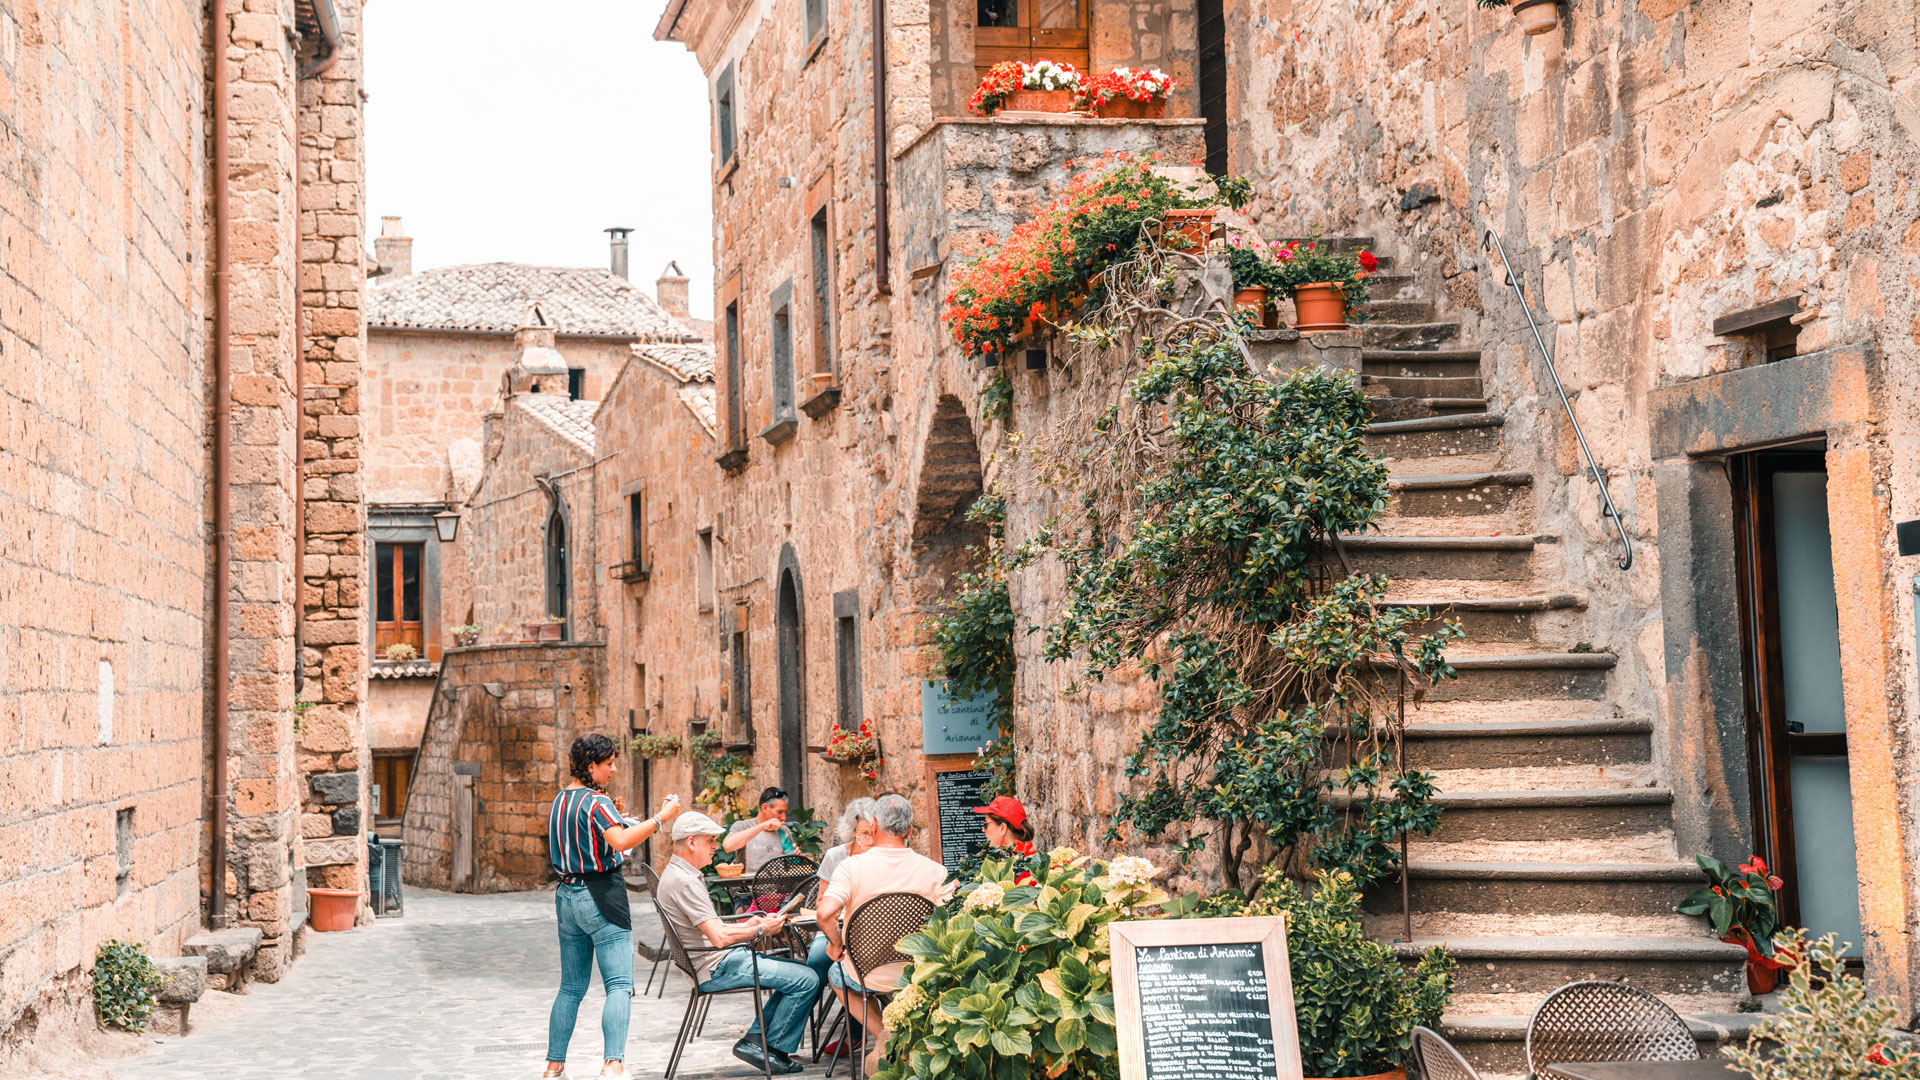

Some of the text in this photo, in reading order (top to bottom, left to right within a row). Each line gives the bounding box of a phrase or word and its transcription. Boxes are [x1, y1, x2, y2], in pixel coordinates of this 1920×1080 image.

[951, 705, 985, 715] cantina
[970, 717, 980, 726] di
[944, 733, 982, 743] Arianna
[1157, 947, 1198, 961] Cantina
[1198, 946, 1209, 958] di
